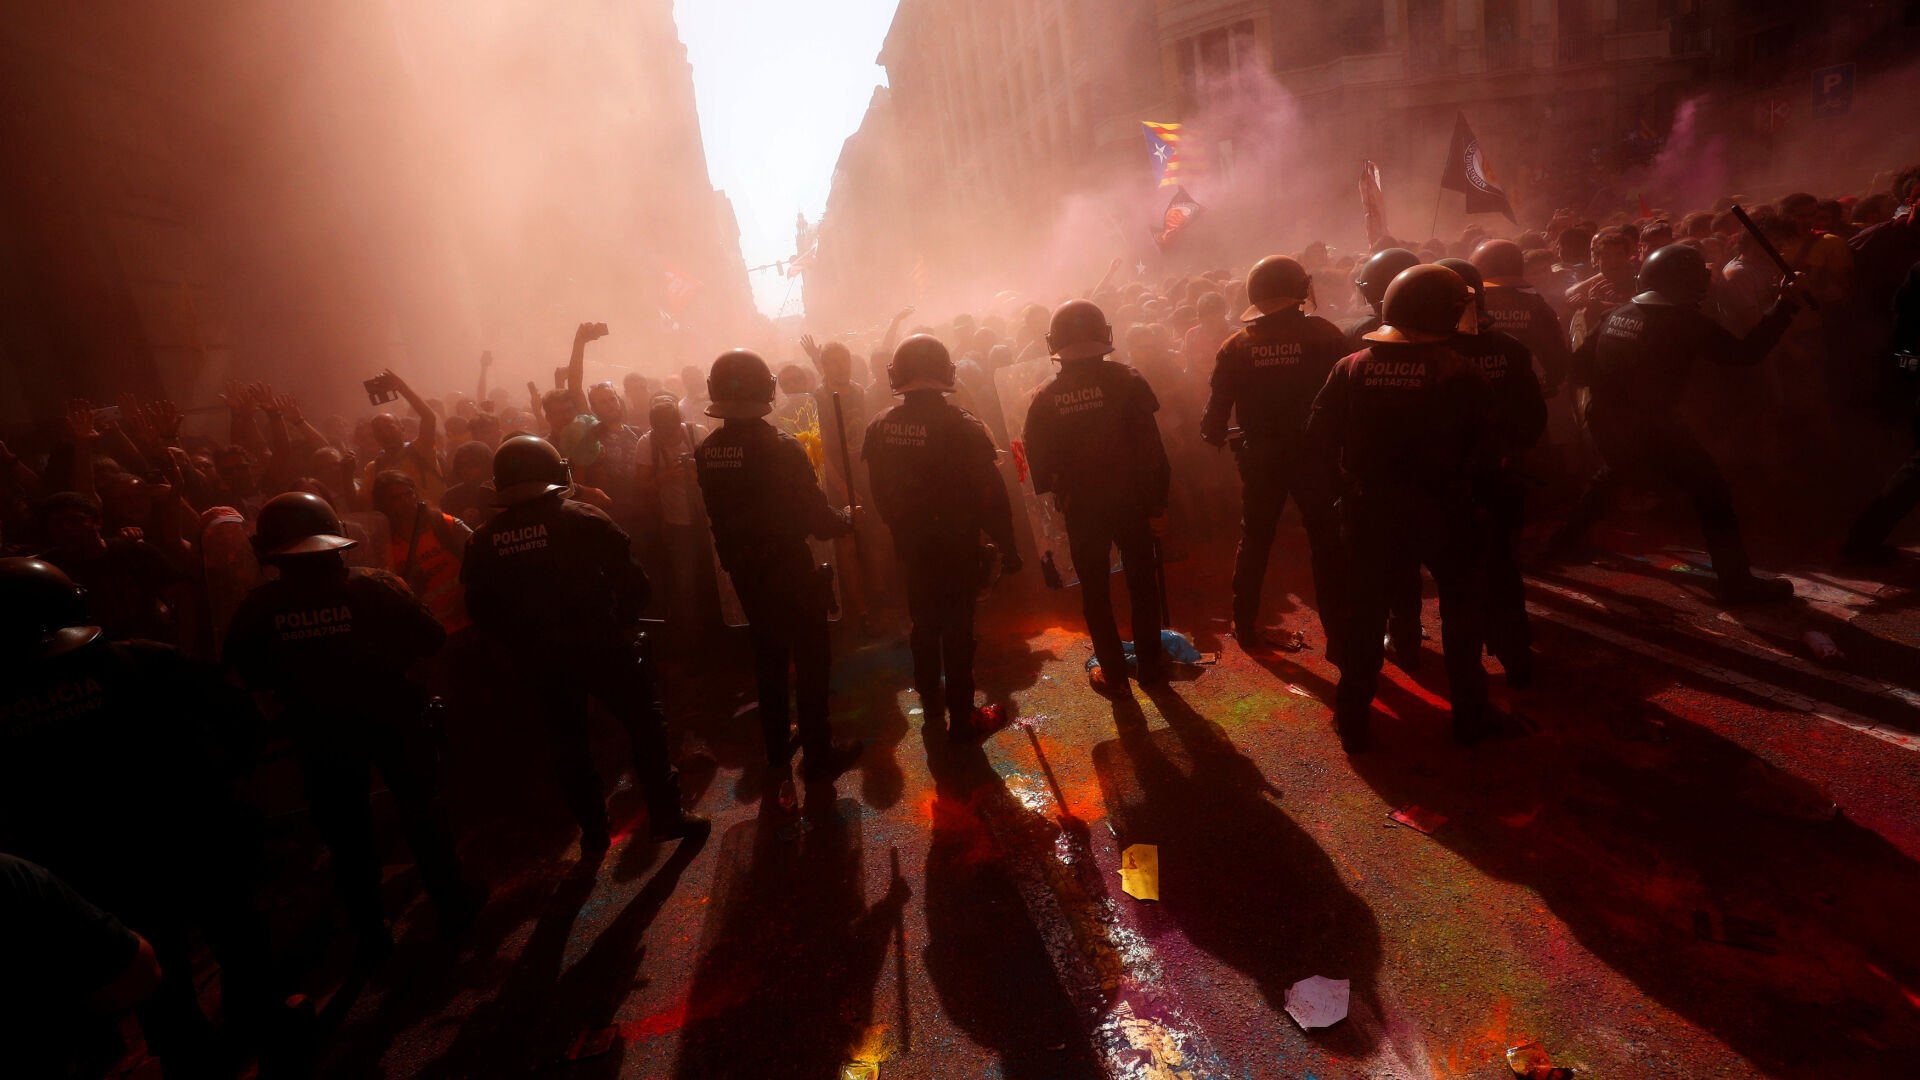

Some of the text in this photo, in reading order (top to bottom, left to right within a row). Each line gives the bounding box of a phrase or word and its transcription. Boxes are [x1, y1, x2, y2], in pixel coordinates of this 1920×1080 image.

[1609, 315, 1644, 332] POLICIA
[1251, 343, 1302, 358] POLICIA
[1364, 362, 1424, 376] POLICIA
[1055, 386, 1103, 407] POLICIA
[883, 424, 927, 438] POLICIA
[704, 447, 744, 459] POLICIA
[492, 524, 548, 546] POLICIA
[274, 605, 352, 631] POLICIA
